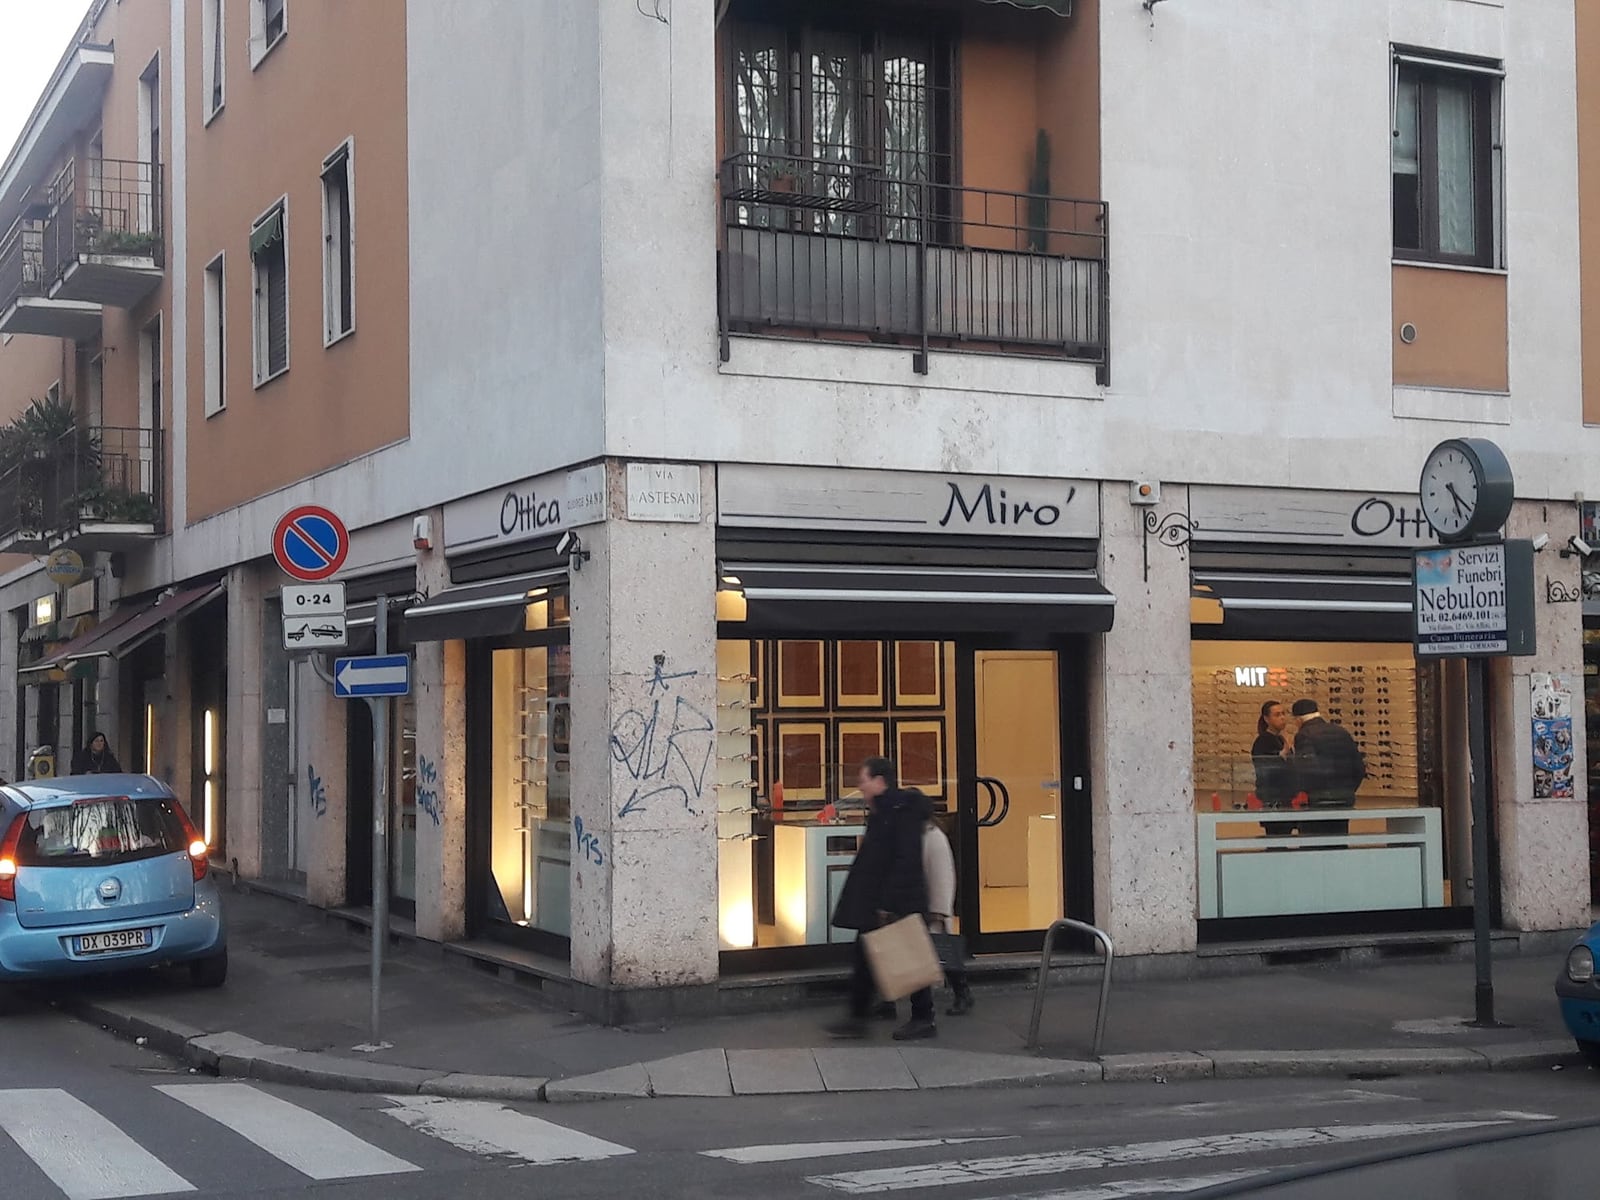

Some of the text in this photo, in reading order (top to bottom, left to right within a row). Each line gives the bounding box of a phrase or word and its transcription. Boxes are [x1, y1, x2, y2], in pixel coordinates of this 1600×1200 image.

[655, 470, 674, 480] VIA
[500, 491, 561, 536] Ottica
[938, 481, 1077, 527] Miro'
[1352, 497, 1434, 538] Otti
[1458, 547, 1499, 565] Servizi
[1457, 565, 1502, 584] Funebri
[296, 594, 331, 605] 0-24
[1419, 582, 1505, 611] Nebuloni
[1420, 613, 1437, 623] Tel.
[82, 931, 143, 950] DX 039PR
